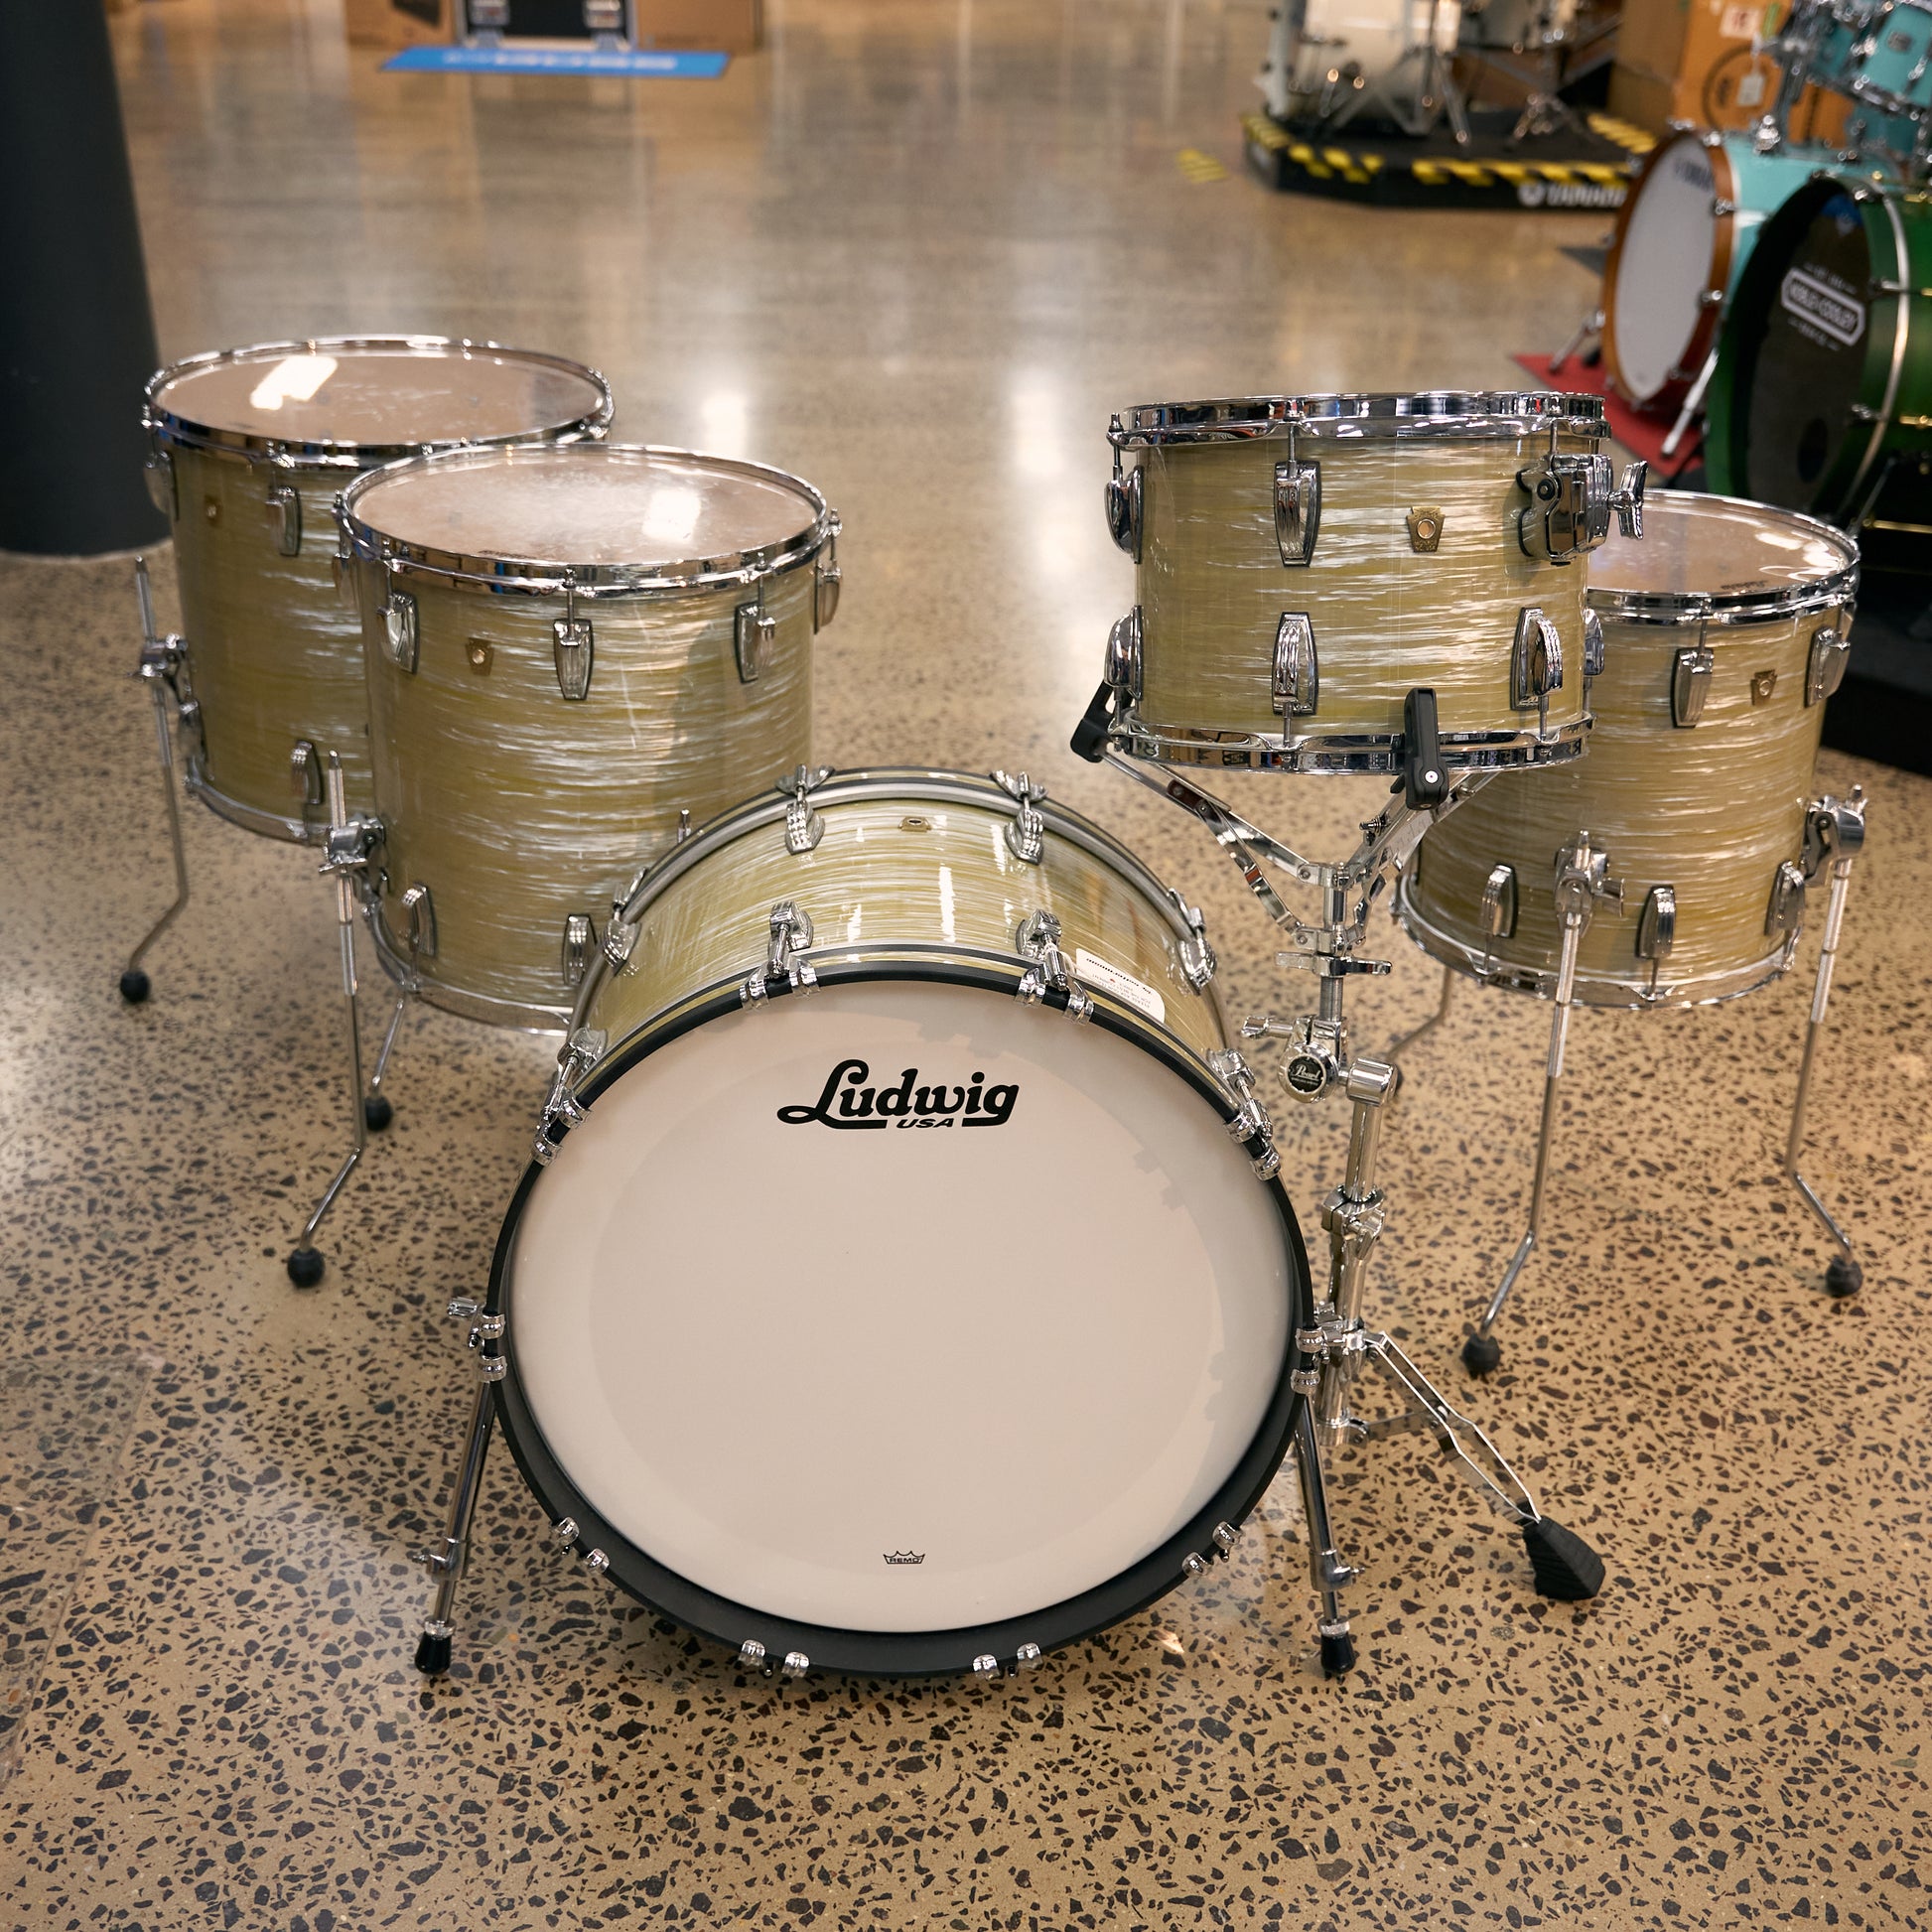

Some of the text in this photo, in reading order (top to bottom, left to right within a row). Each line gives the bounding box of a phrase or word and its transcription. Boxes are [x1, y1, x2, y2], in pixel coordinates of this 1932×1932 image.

[1295, 1063, 1320, 1080] Pearl
[776, 1058, 1020, 1129] Ludwig
[896, 1118, 954, 1128] USA
